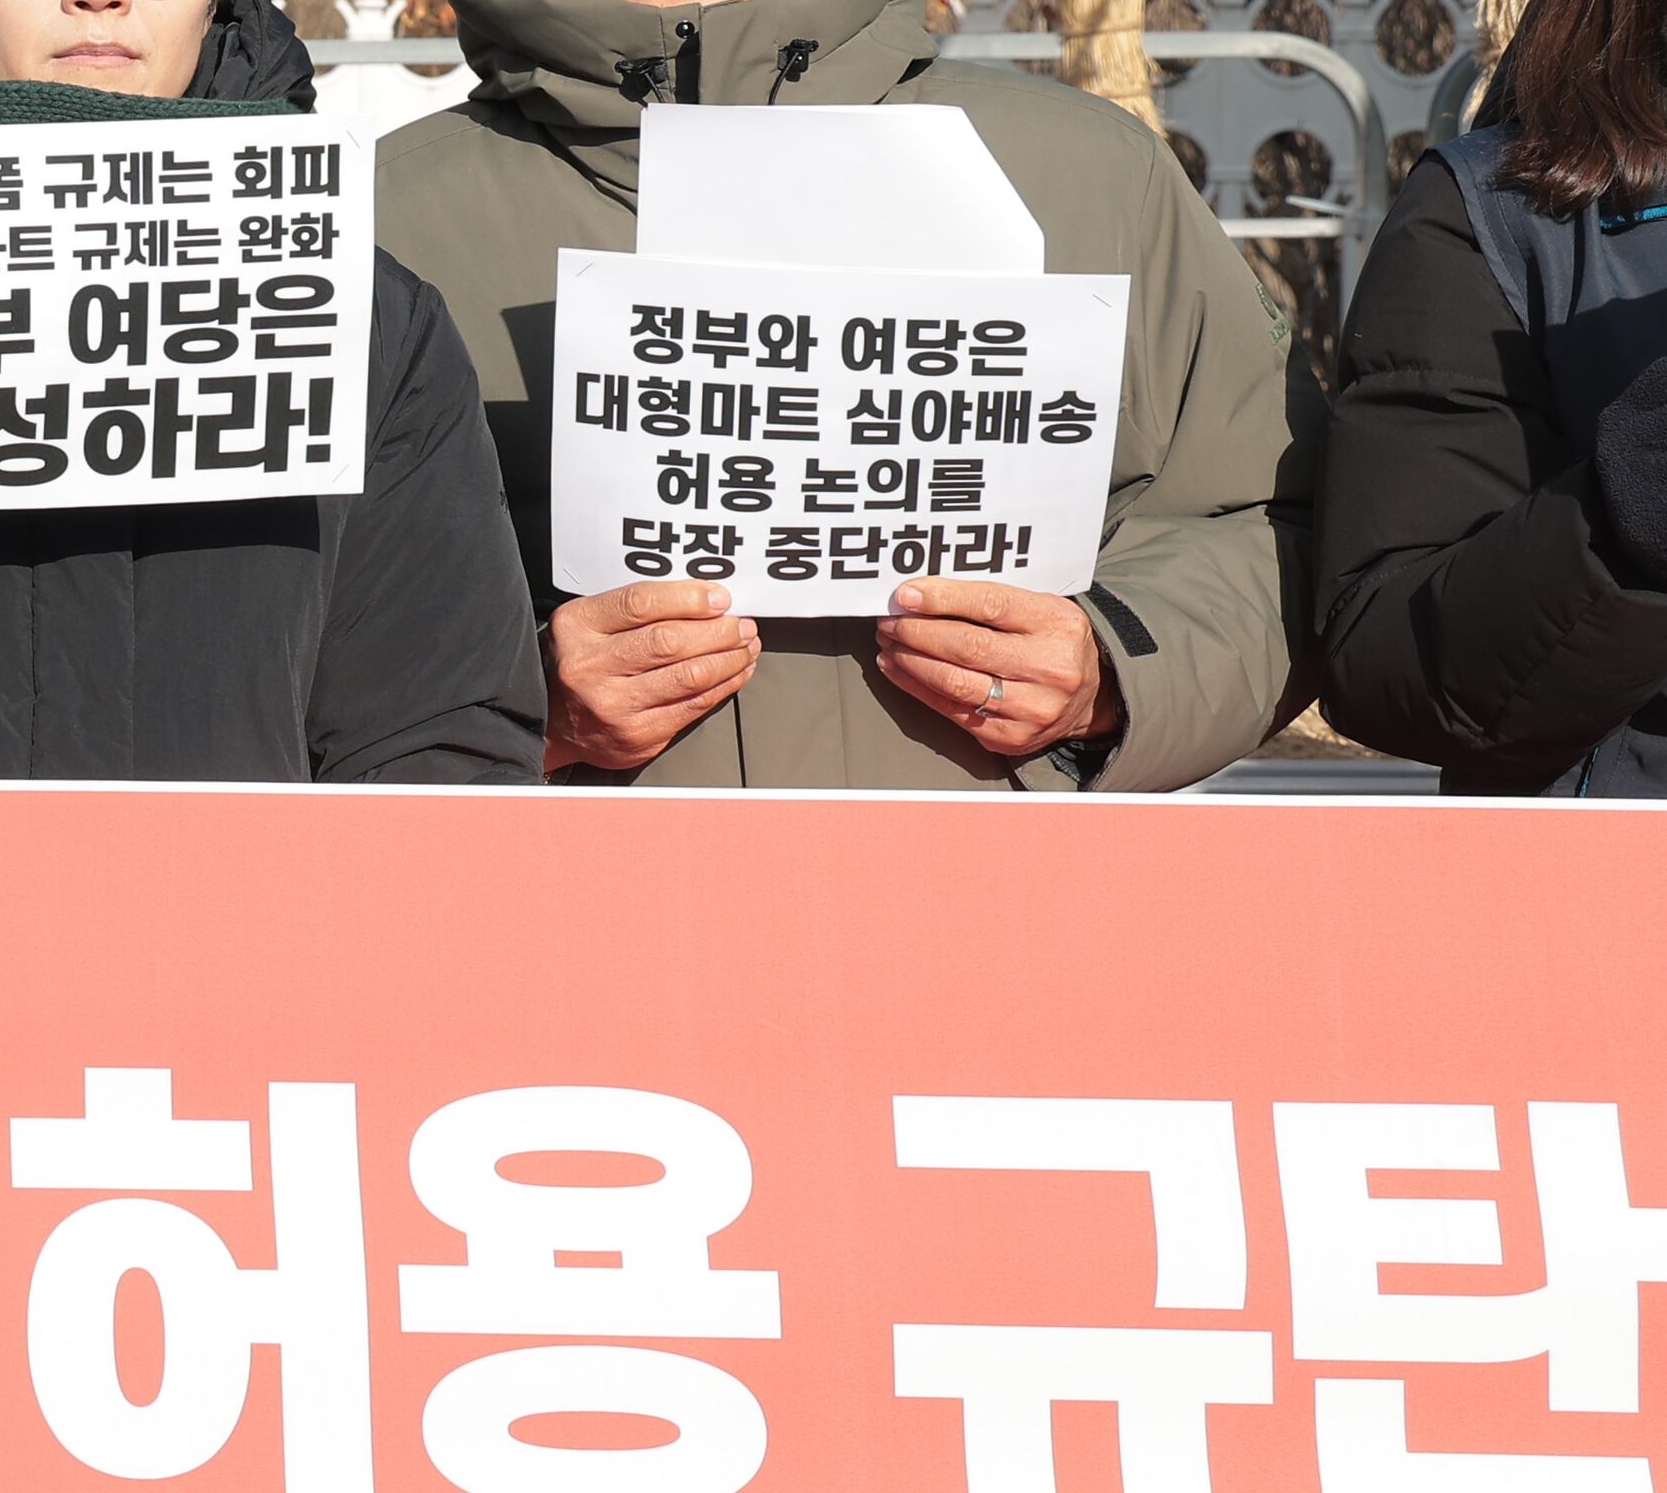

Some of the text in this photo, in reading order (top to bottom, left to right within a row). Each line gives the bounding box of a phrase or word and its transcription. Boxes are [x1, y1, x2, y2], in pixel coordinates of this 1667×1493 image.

[44, 151, 212, 208] 규제는
[233, 144, 340, 199] 회피
[73, 220, 221, 270] 규제는
[239, 213, 339, 263] 완화
[69, 275, 337, 365] 여당은
[631, 305, 1027, 376] 정부와 여당은
[576, 372, 1096, 445] 대형마트 심야배송
[657, 450, 985, 512] 허용 논의를
[623, 518, 1031, 580] 당장 중단하라!
[10, 1068, 781, 1493] 허용
[893, 1096, 1667, 1493] 규탄
